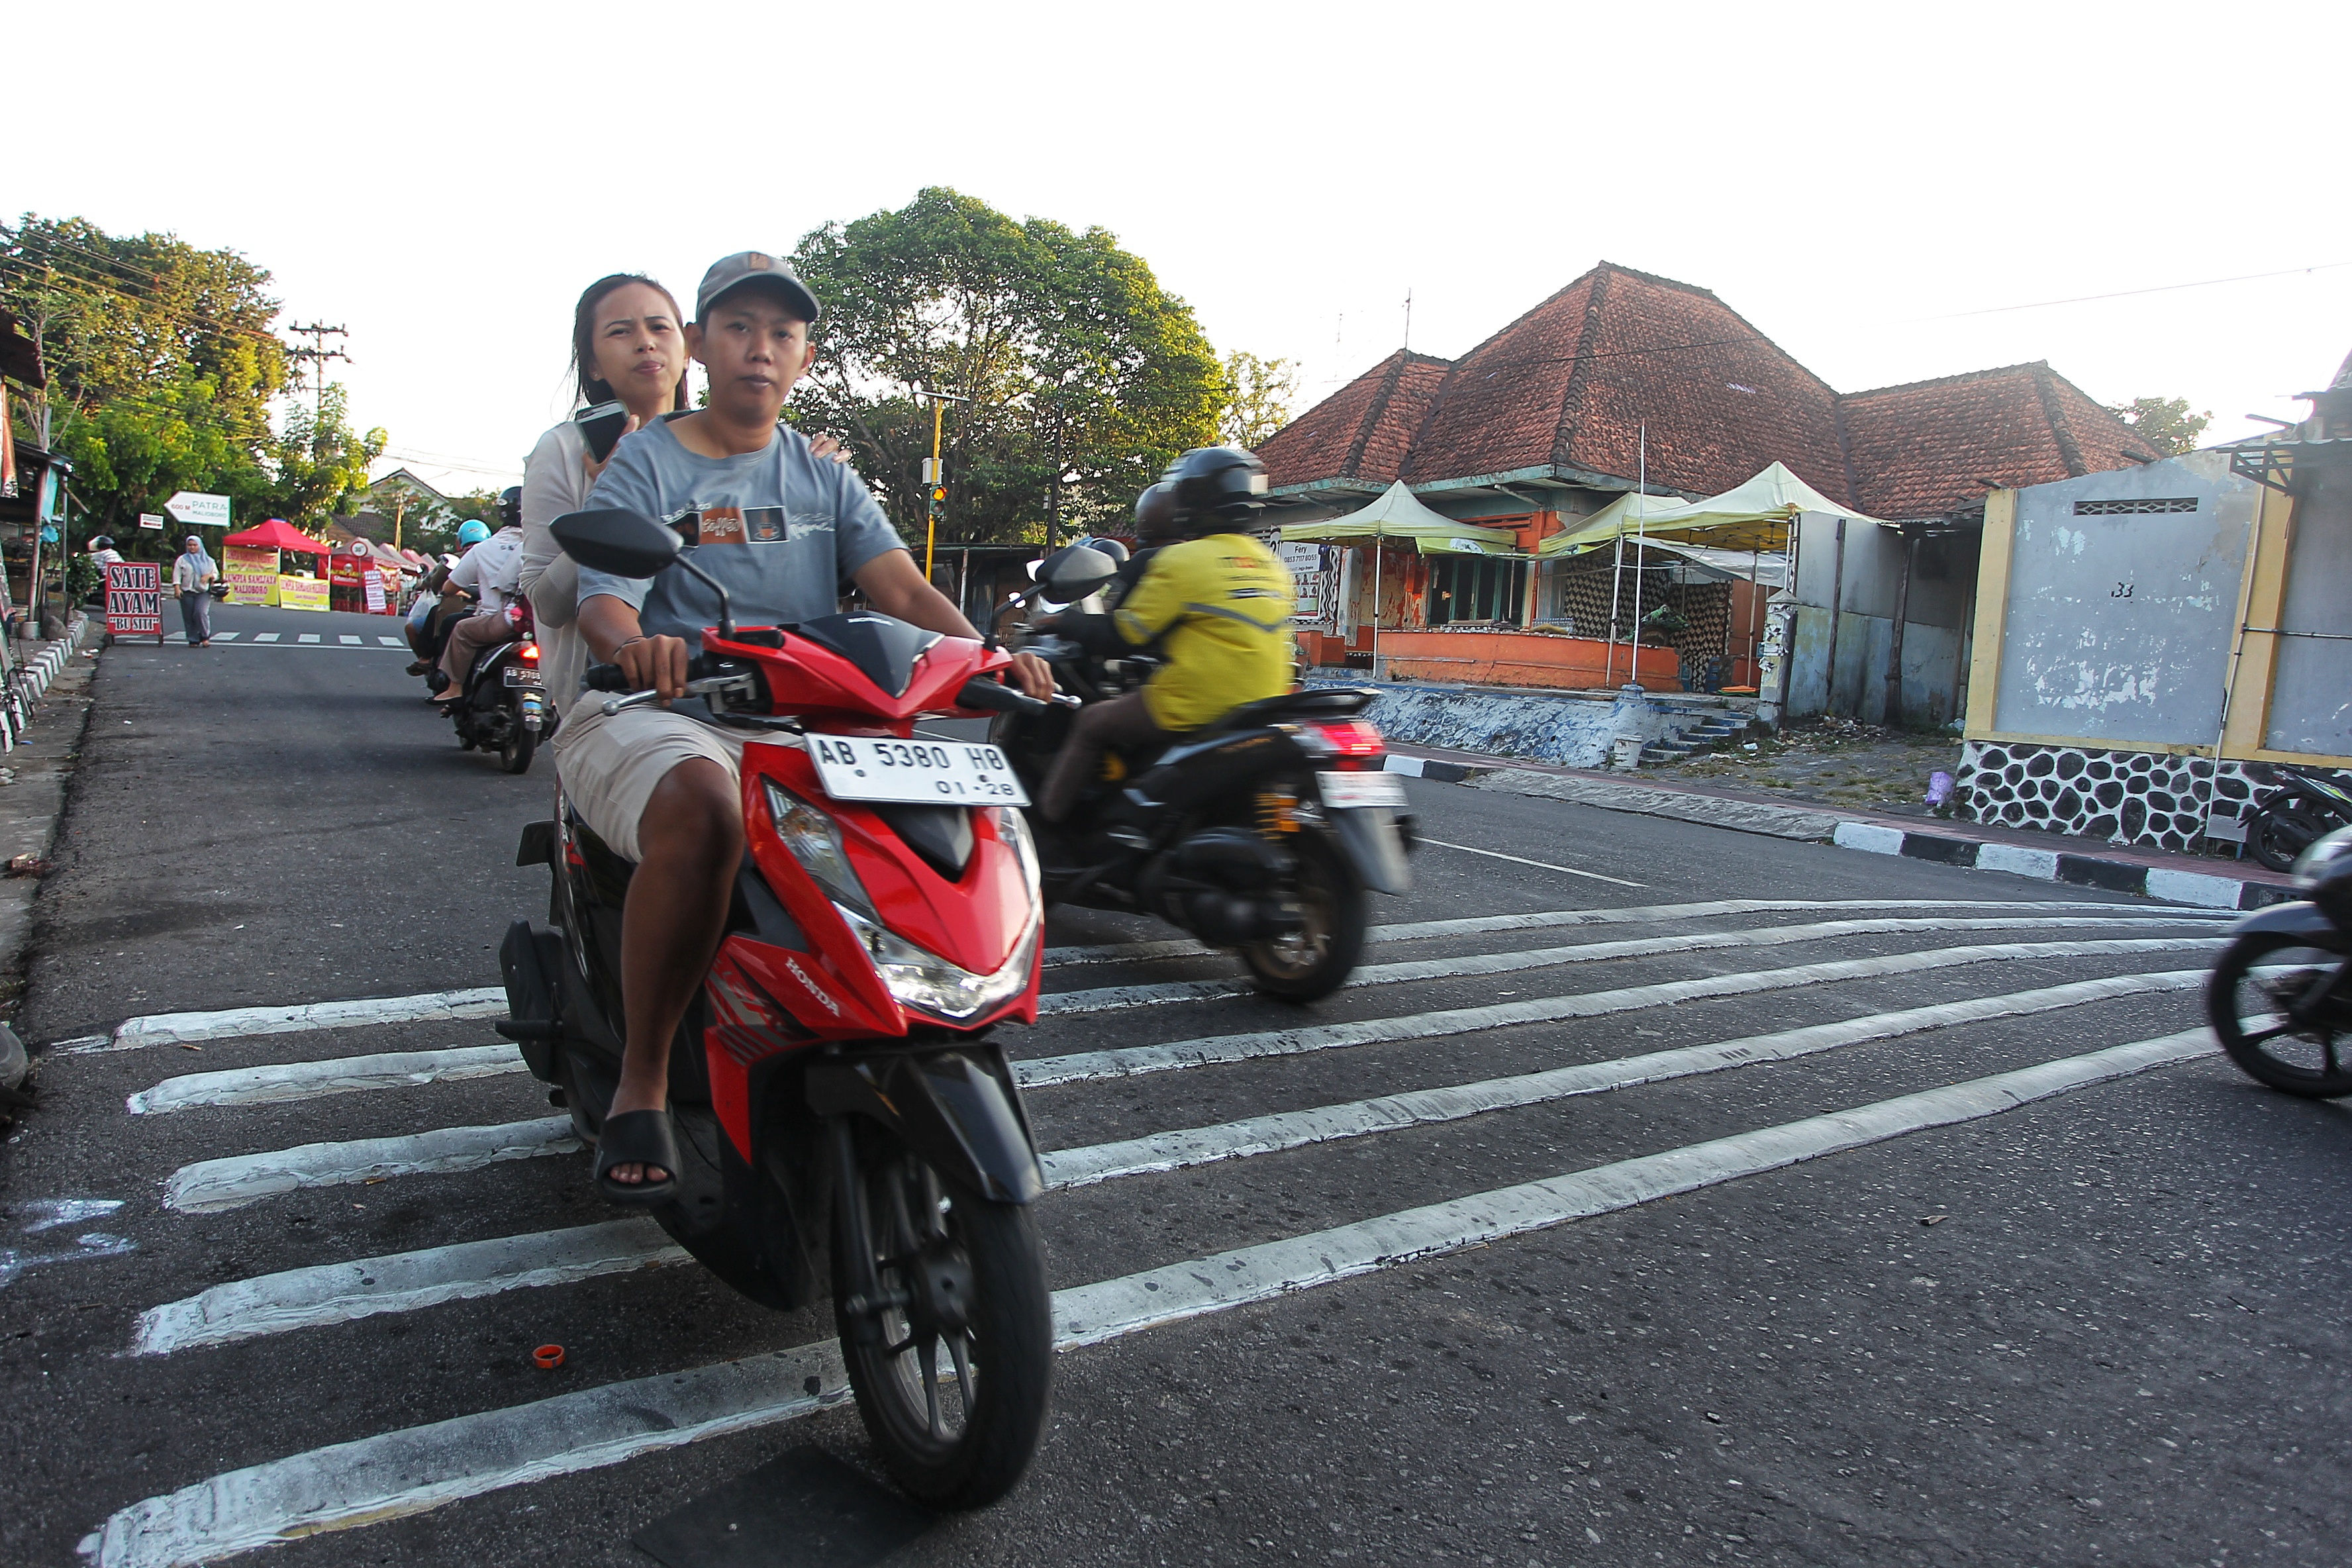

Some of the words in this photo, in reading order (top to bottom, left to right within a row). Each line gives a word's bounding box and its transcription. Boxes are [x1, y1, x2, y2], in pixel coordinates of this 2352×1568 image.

[1295, 545, 1307, 554] Fery
[110, 566, 156, 589] SATE
[108, 591, 160, 614] AYAM
[818, 740, 857, 765] AB
[873, 743, 951, 769] 5380
[785, 956, 840, 1018] HONDA
